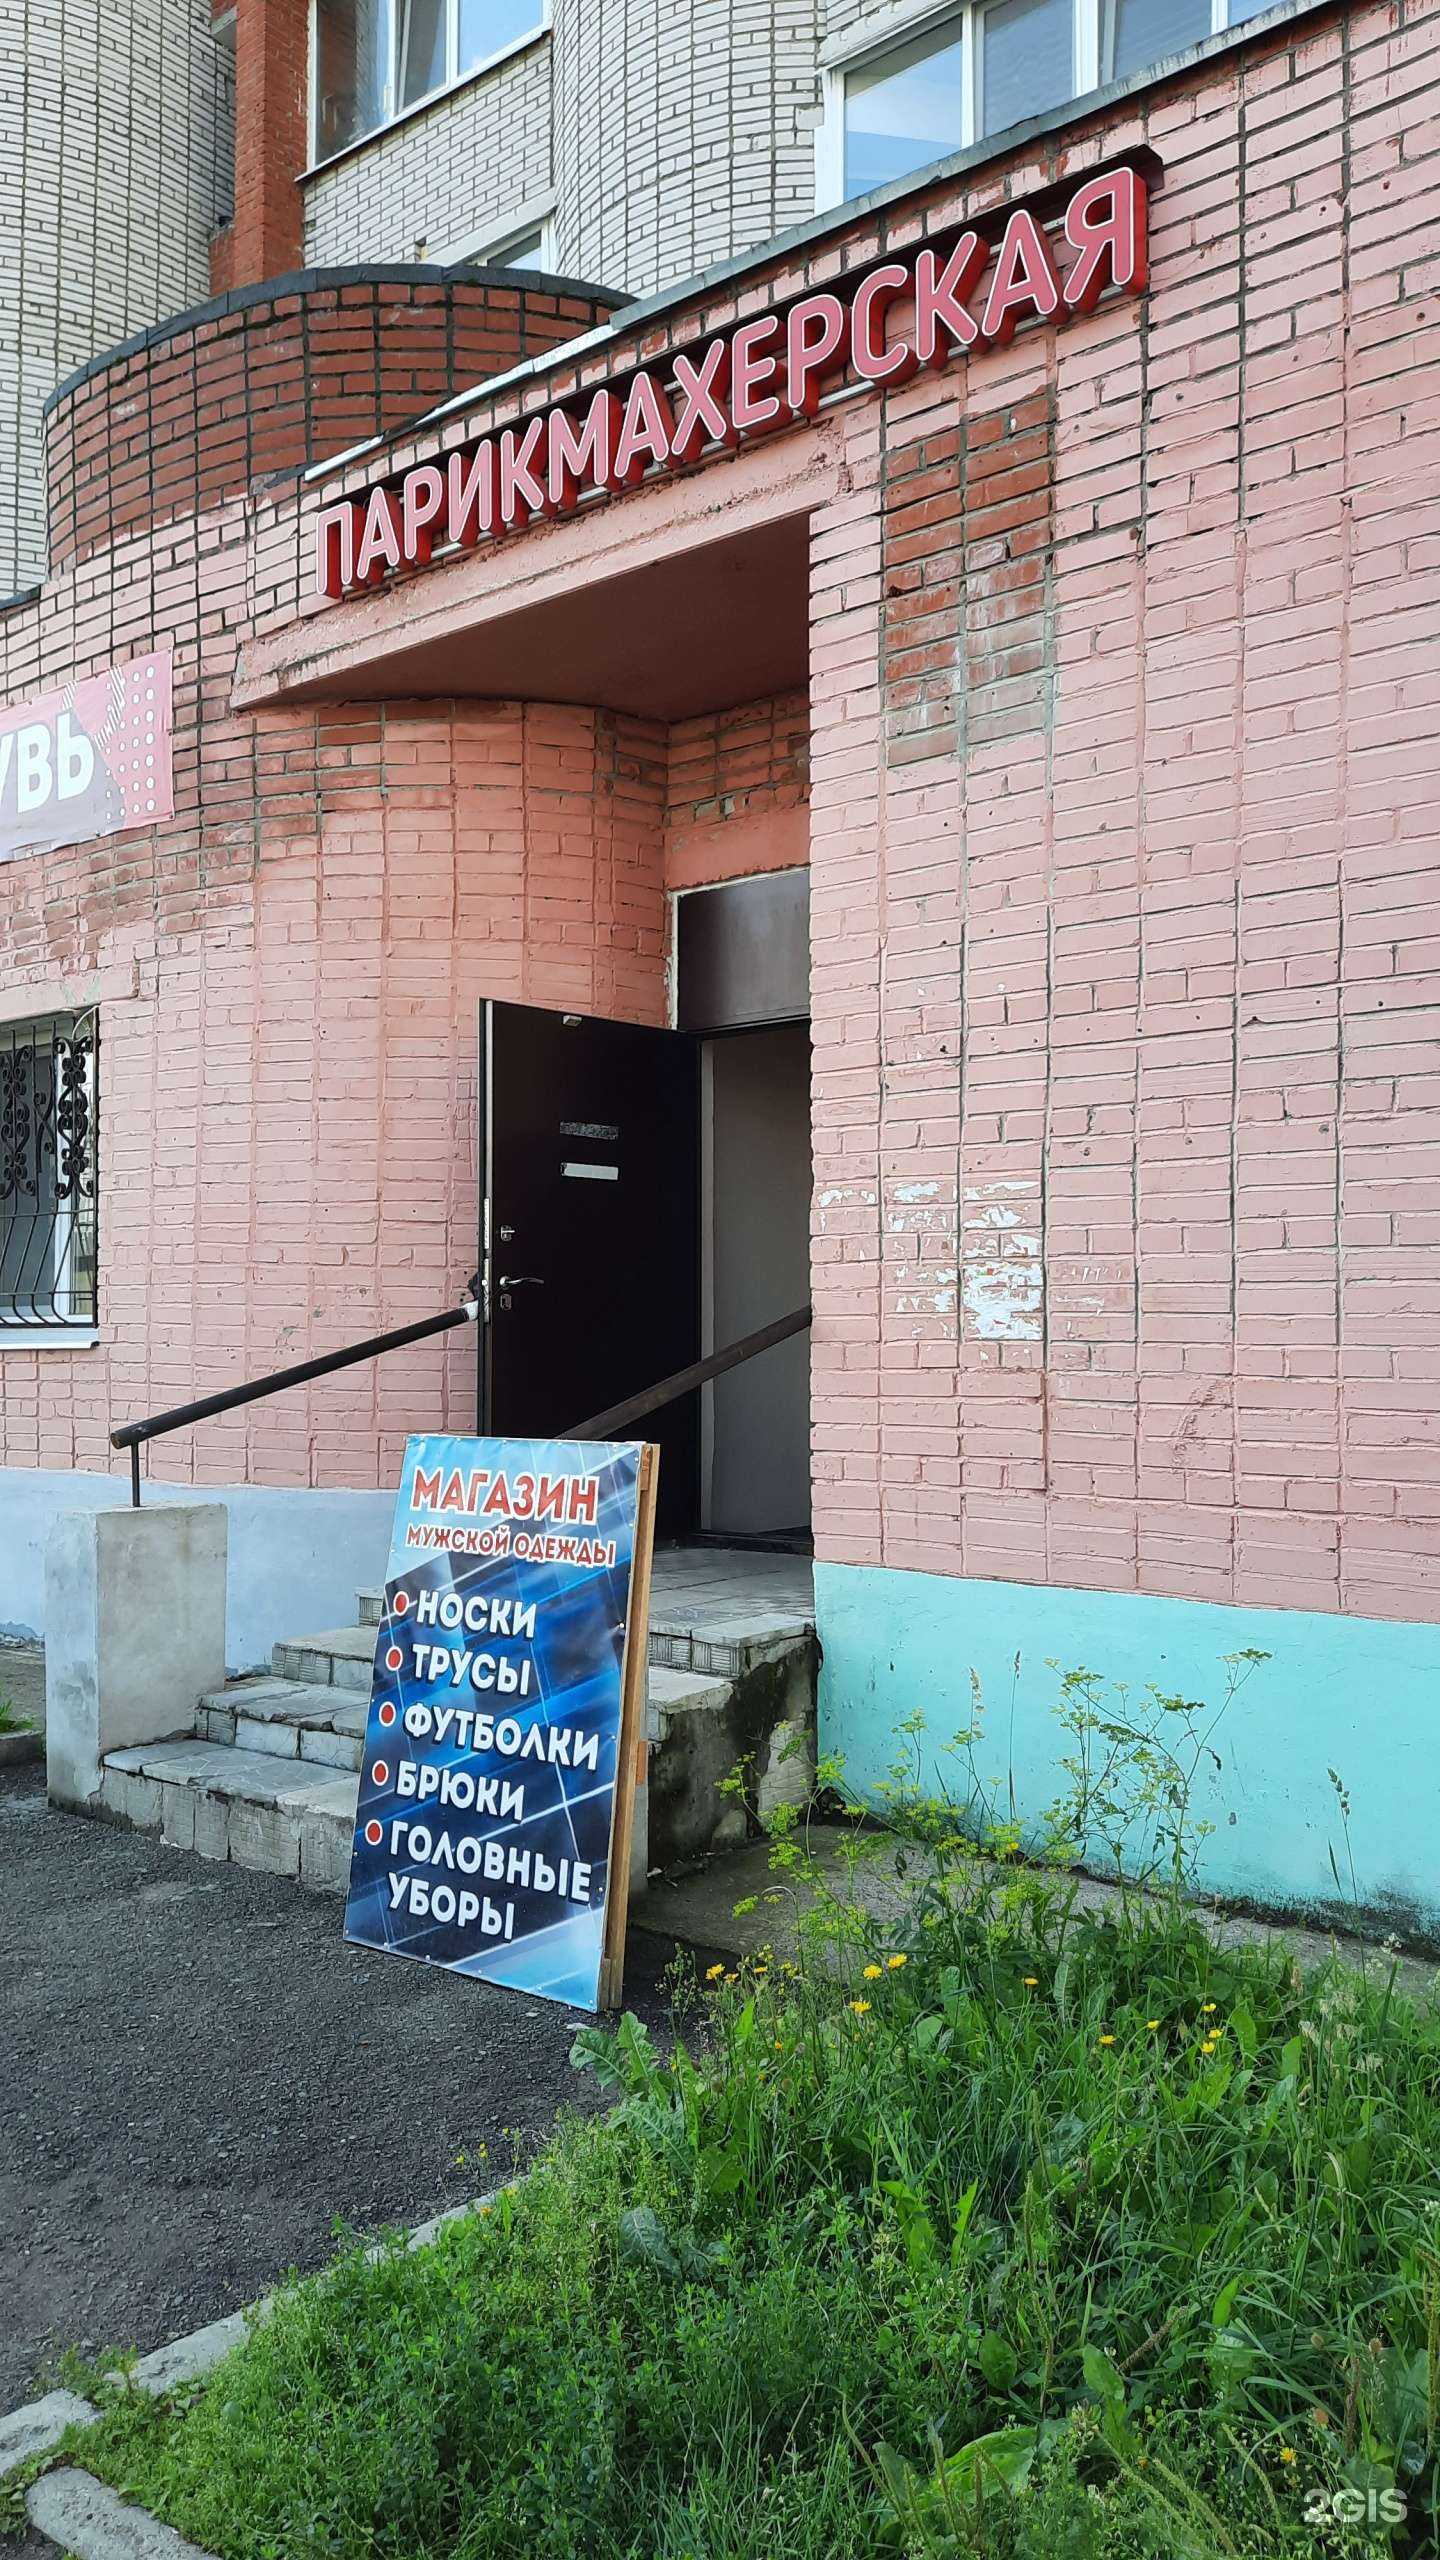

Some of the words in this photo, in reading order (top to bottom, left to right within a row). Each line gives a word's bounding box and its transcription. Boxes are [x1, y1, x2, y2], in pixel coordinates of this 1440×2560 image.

[316, 168, 1148, 598] ПАРИКМАХЕРСКАЯ
[410, 1466, 601, 1525] МАГАЗИН
[405, 1524, 511, 1558] МУЖСКОЙ
[513, 1534, 616, 1567] ОДЕЖДЫ
[416, 1590, 536, 1638] НОСКИ
[412, 1644, 531, 1695] ТРУСЫ
[404, 1703, 599, 1770] ФУТБОЛКИ
[396, 1761, 525, 1821] БРЮКИ
[390, 1821, 592, 1902] ГОЛОВНЫЕ
[388, 1873, 515, 1940] УБОРЫ
